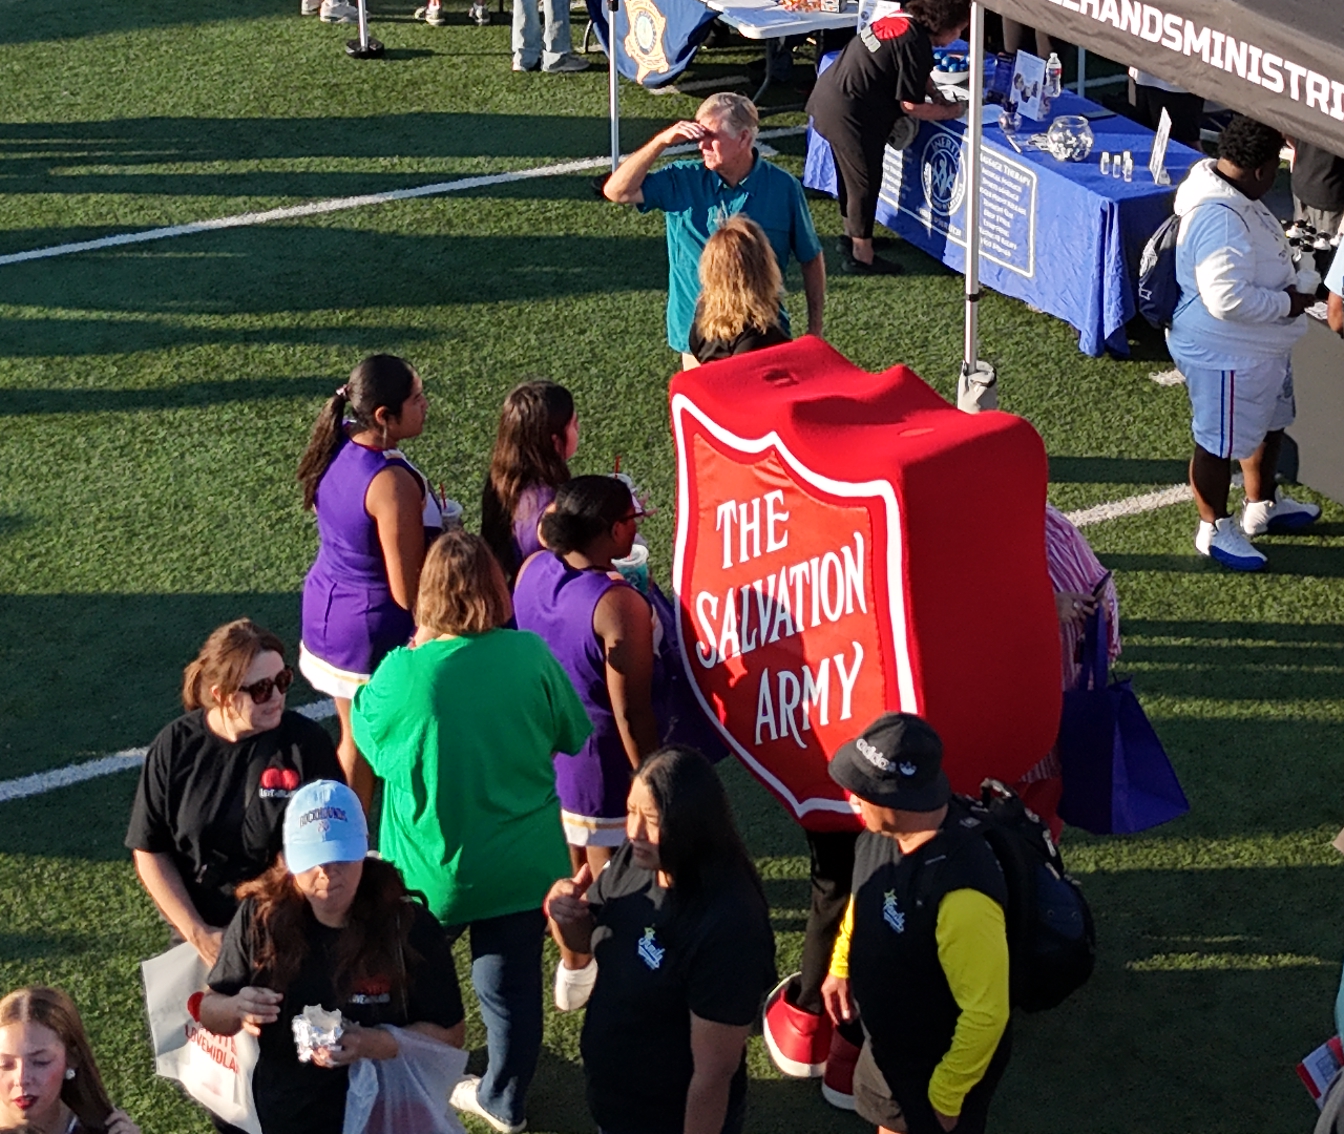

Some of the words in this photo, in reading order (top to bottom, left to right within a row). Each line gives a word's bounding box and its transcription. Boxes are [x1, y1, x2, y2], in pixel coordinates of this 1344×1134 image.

[715, 488, 791, 570] THE
[694, 531, 868, 670] SALVATION
[755, 641, 865, 750] ARMY
[856, 737, 897, 773] adidas
